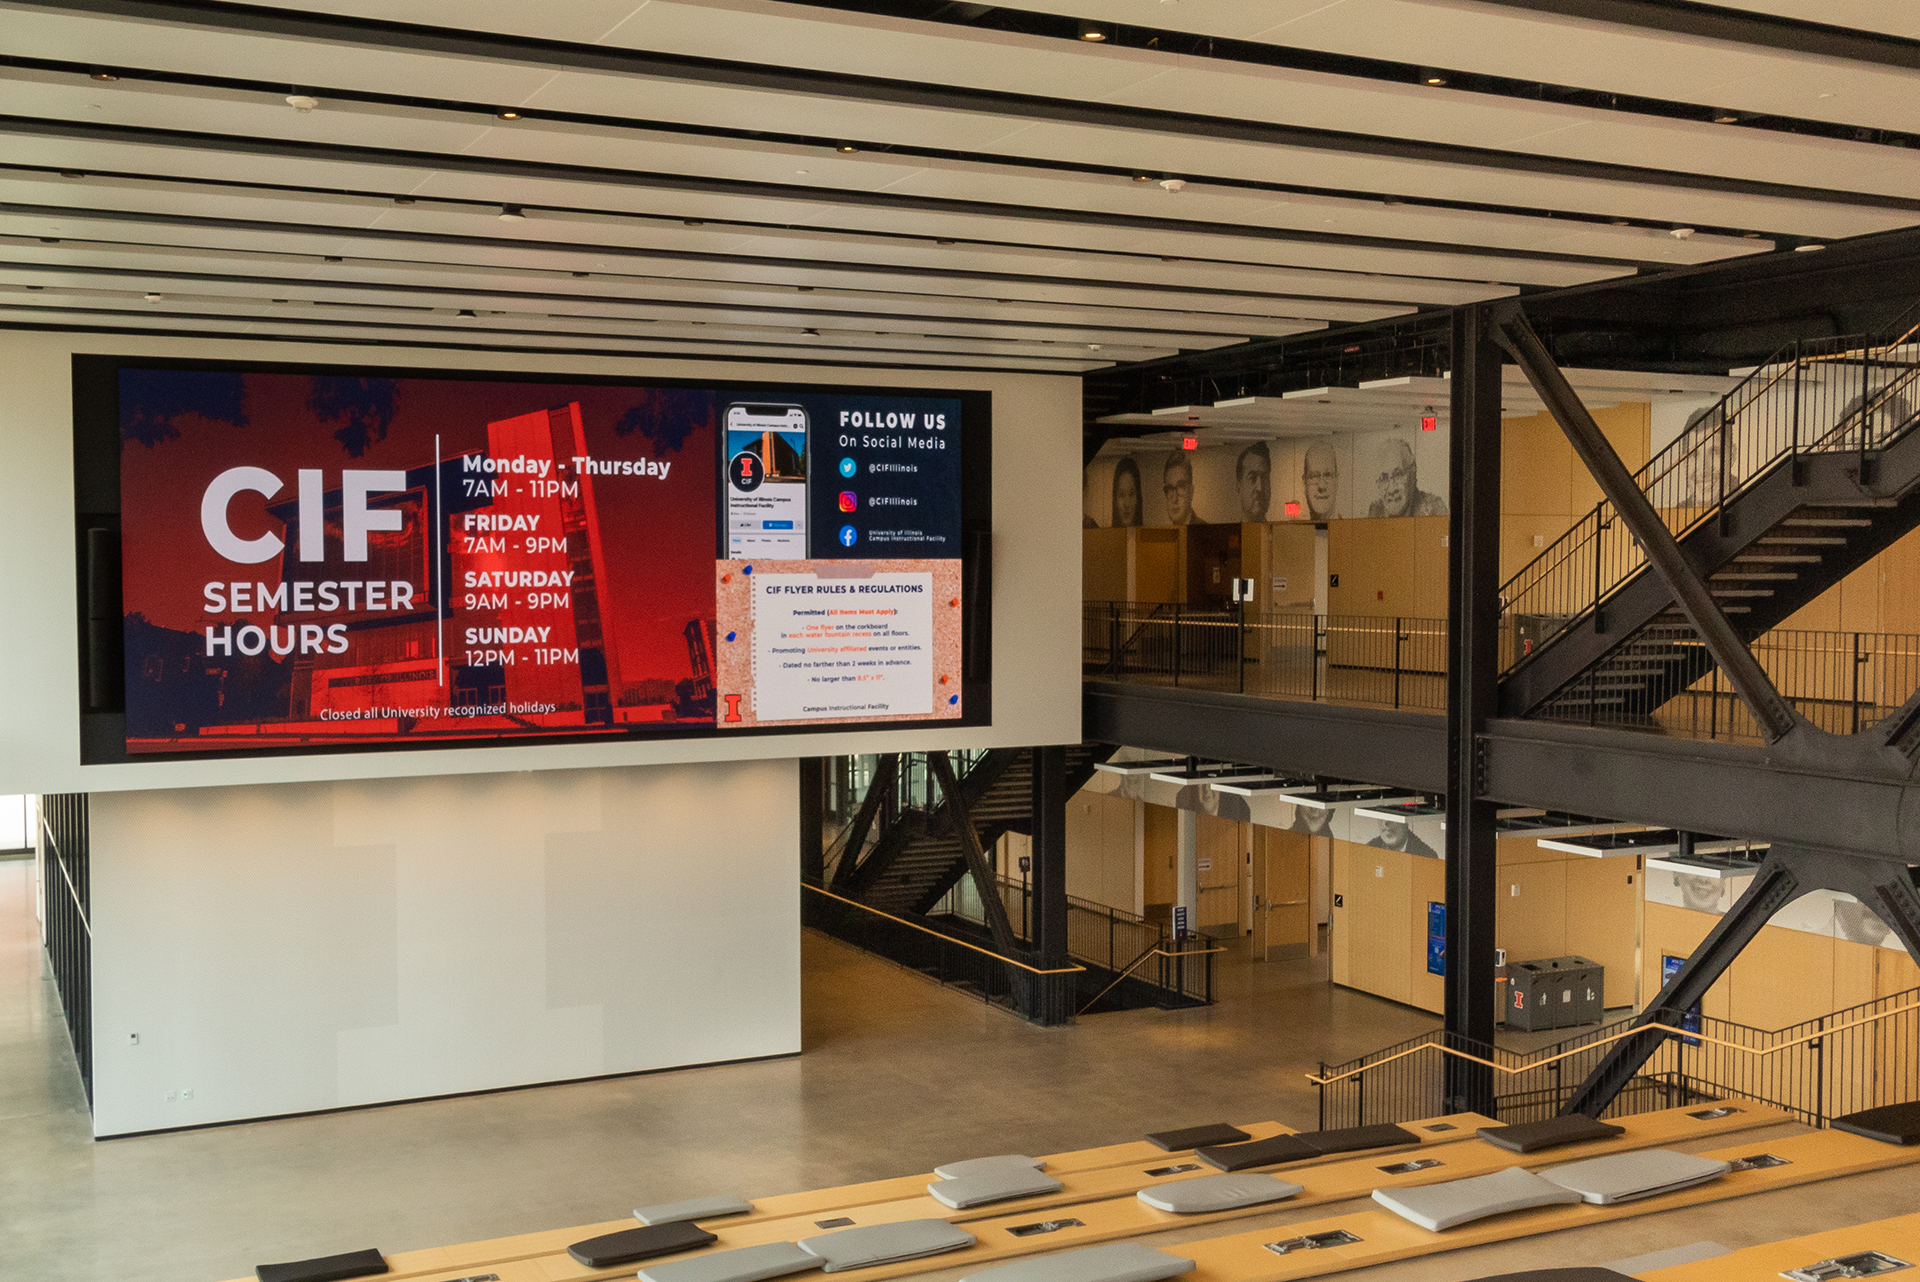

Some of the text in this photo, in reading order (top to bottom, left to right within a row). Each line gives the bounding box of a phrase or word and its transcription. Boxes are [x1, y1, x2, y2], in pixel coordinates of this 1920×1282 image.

[840, 411, 946, 430] FOLLOW US
[839, 435, 945, 449] On Social Media
[463, 454, 551, 478] Monday
[572, 456, 671, 480] Thursday
[869, 464, 918, 473] @CIFIllinois
[463, 479, 508, 497] 7AM
[529, 480, 578, 498] 11PM
[869, 497, 918, 507] @CIFIllinois
[201, 466, 407, 564] CIF
[464, 514, 540, 531] FRIDAY
[464, 537, 506, 554] 7AM
[525, 537, 568, 554] 9PM
[464, 571, 575, 588] SATURDAY
[203, 581, 414, 614] SEMESTER
[766, 585, 923, 594] CIF FLYER RULES & REGULATIONS
[465, 593, 508, 610] 9AM
[527, 592, 569, 609] 9PM
[206, 624, 349, 656] HOURS
[465, 626, 551, 645] SUNDAY
[465, 649, 515, 667] 12PM
[534, 648, 579, 665] 11PM
[320, 702, 556, 721] Closed all University recognized holidays
